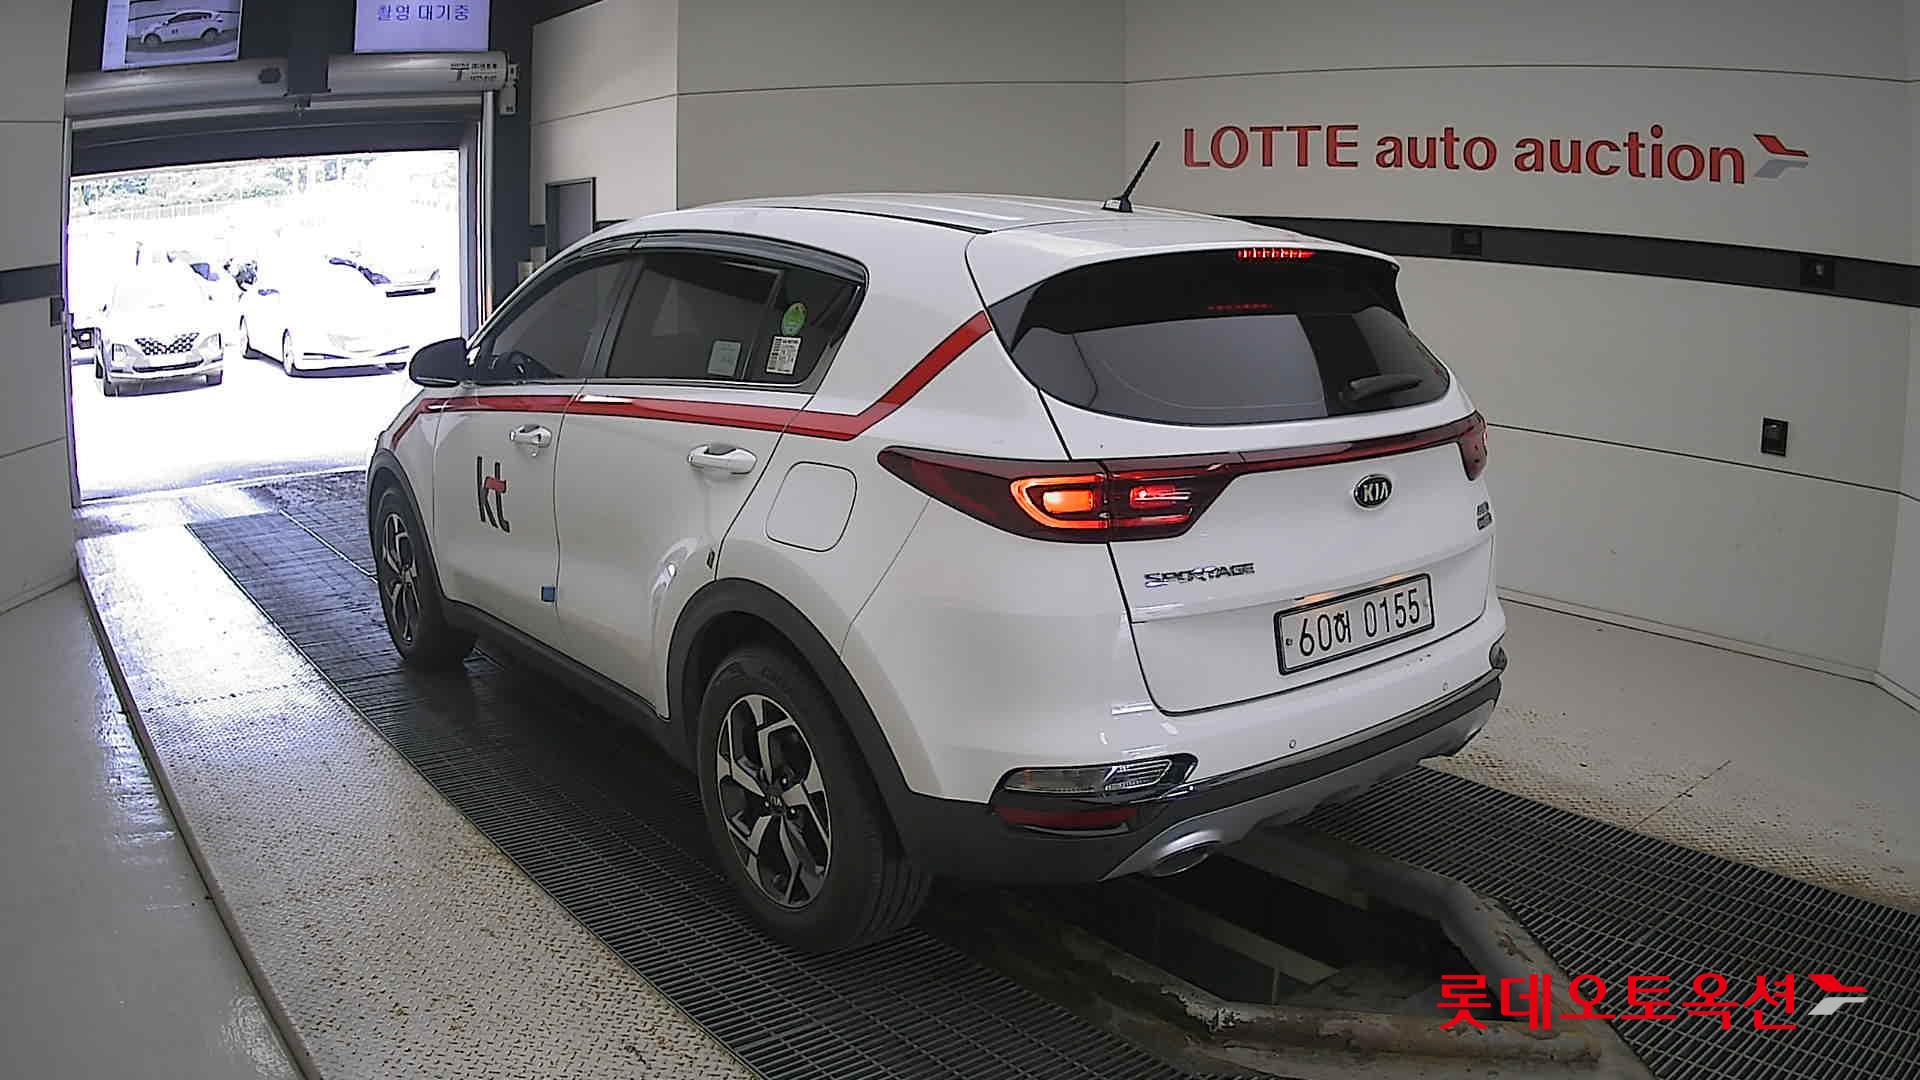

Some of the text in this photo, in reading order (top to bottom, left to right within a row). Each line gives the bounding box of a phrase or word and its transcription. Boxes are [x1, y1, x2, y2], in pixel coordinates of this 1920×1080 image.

[418, 4, 469, 21] 대기중
[1184, 125, 1744, 184] LOTTE auto auction
[477, 456, 510, 533] kt
[1362, 481, 1389, 502] KIA
[1299, 588, 1420, 657] 60허 0155
